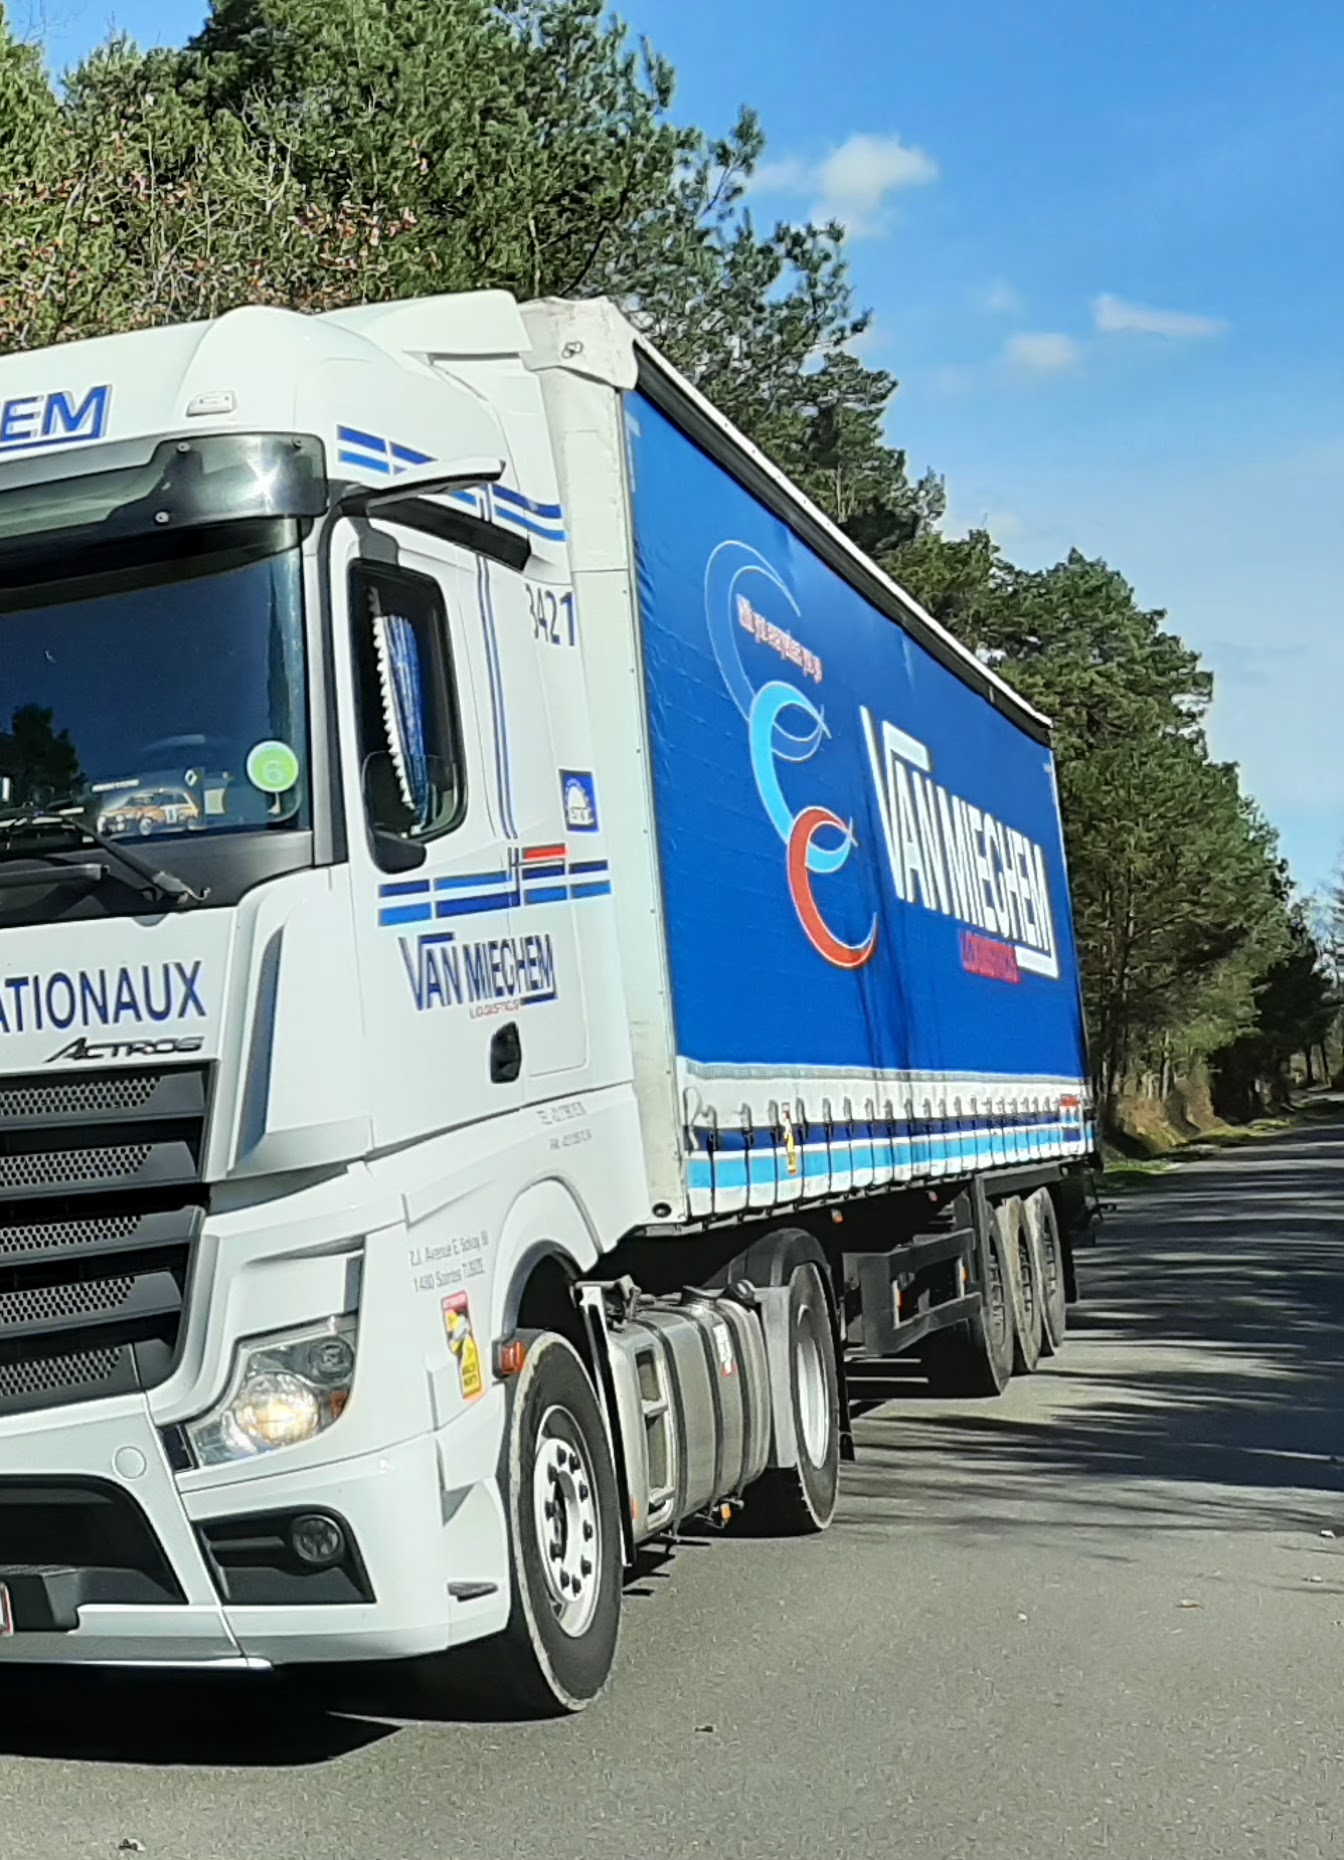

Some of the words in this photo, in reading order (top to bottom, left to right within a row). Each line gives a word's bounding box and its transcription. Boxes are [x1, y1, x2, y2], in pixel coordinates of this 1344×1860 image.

[525, 583, 575, 646] 3421
[860, 705, 951, 916] VAN
[936, 785, 1058, 979] MIEGHEM
[398, 932, 464, 1011] VAN
[462, 934, 558, 1006] MIEGHEM
[43, 1036, 205, 1064] ACTROS
